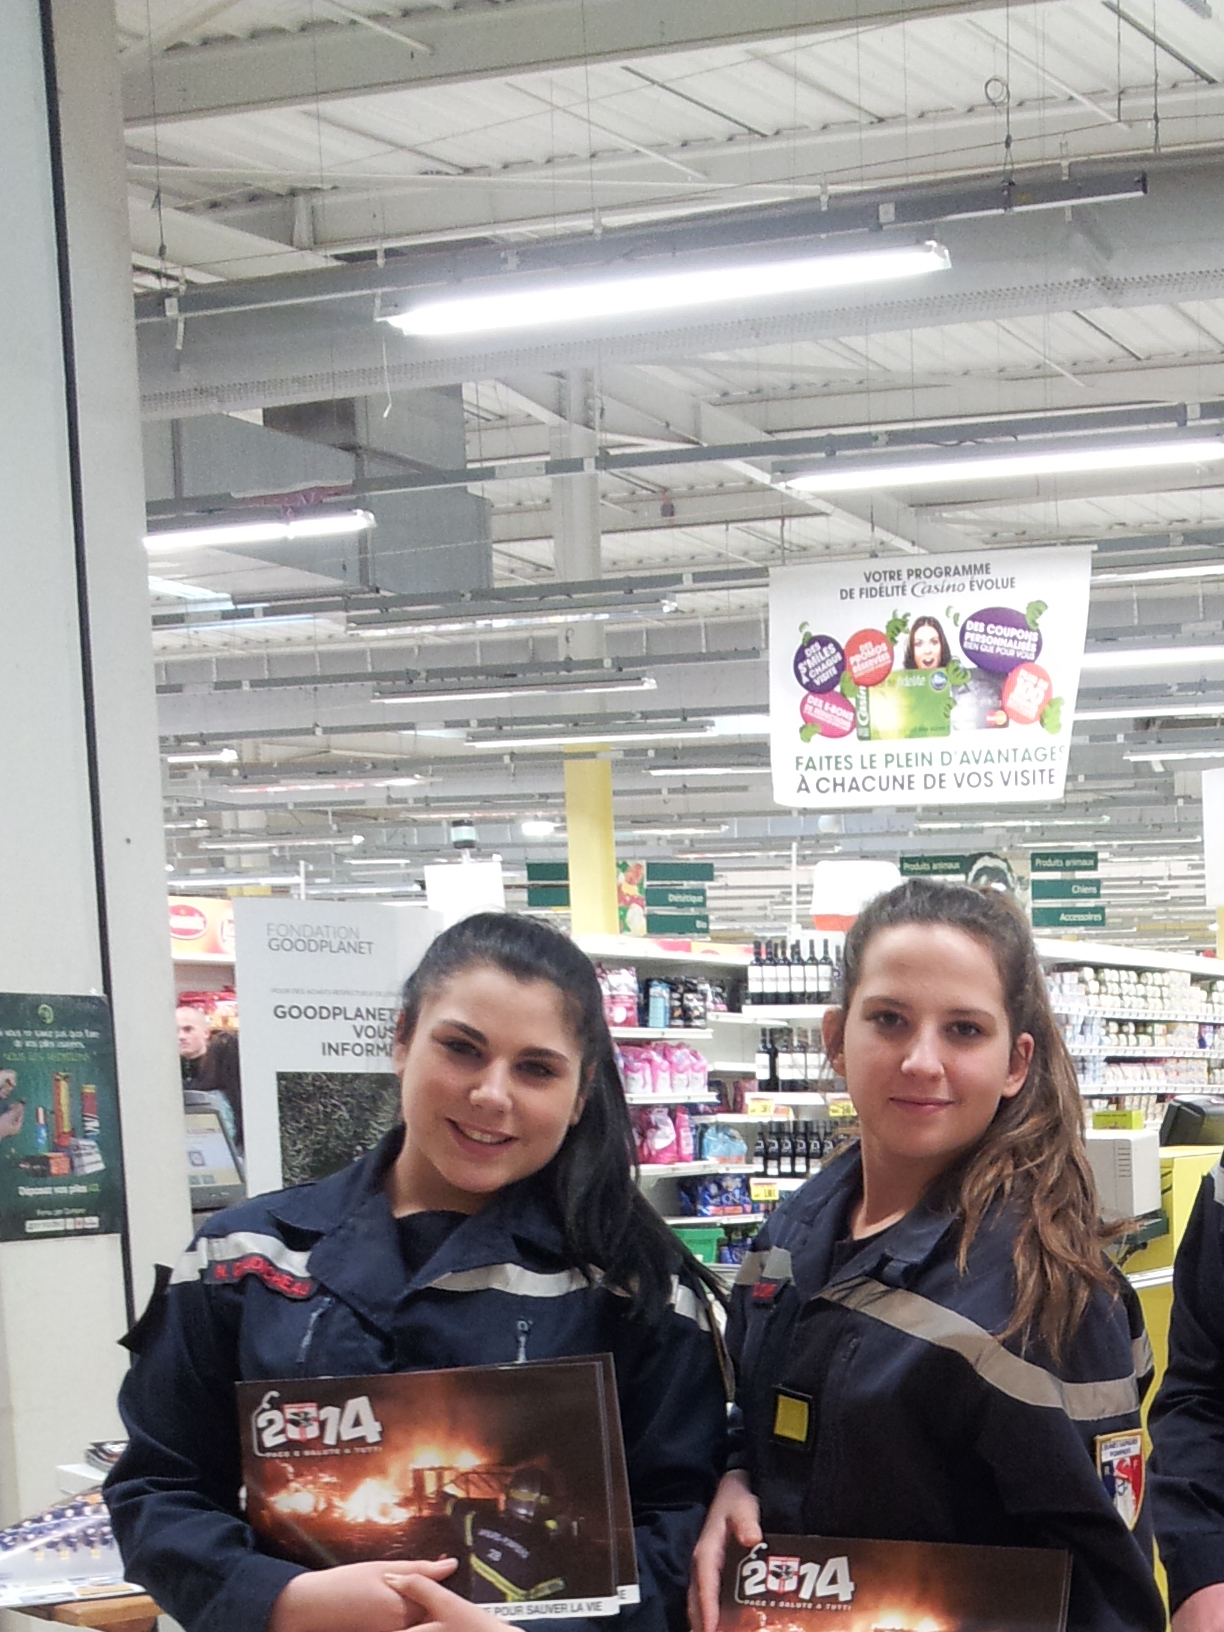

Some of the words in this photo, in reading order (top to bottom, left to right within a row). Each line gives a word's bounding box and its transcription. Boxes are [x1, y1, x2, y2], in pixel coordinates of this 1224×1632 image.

[864, 569, 903, 583] VOTRE
[907, 563, 991, 580] PROGRAMME
[840, 588, 855, 600] DE
[859, 583, 907, 598] FIDÉLITÉ
[911, 580, 966, 597] Casino
[969, 576, 1016, 591] ÉVOLUE
[966, 620, 985, 632] DES
[987, 623, 1038, 642] COUPONS
[795, 755, 853, 771] FAITES
[860, 754, 877, 769] LE
[884, 752, 933, 768] PLEIN
[797, 774, 811, 793] À
[816, 774, 915, 793] CHACUNE
[923, 773, 946, 790] DE
[954, 771, 993, 788] VOS
[903, 861, 930, 871] Produits
[932, 859, 961, 871] animaux
[1035, 857, 1064, 868] Produits
[1065, 857, 1095, 868] animaux
[1071, 884, 1098, 894] Chiens
[1059, 912, 1103, 923] Accessoires
[266, 923, 360, 940] FONDATION
[268, 938, 374, 955] GOODPLANET
[273, 1004, 395, 1021] GOODPLANET
[352, 1025, 396, 1040] VOUS
[494, 1605, 523, 1617] POUR
[526, 1603, 568, 1615] SAUVER
[570, 1602, 584, 1613] LA
[587, 1600, 603, 1612] VIE
[780, 1601, 813, 1609] SALUTE
